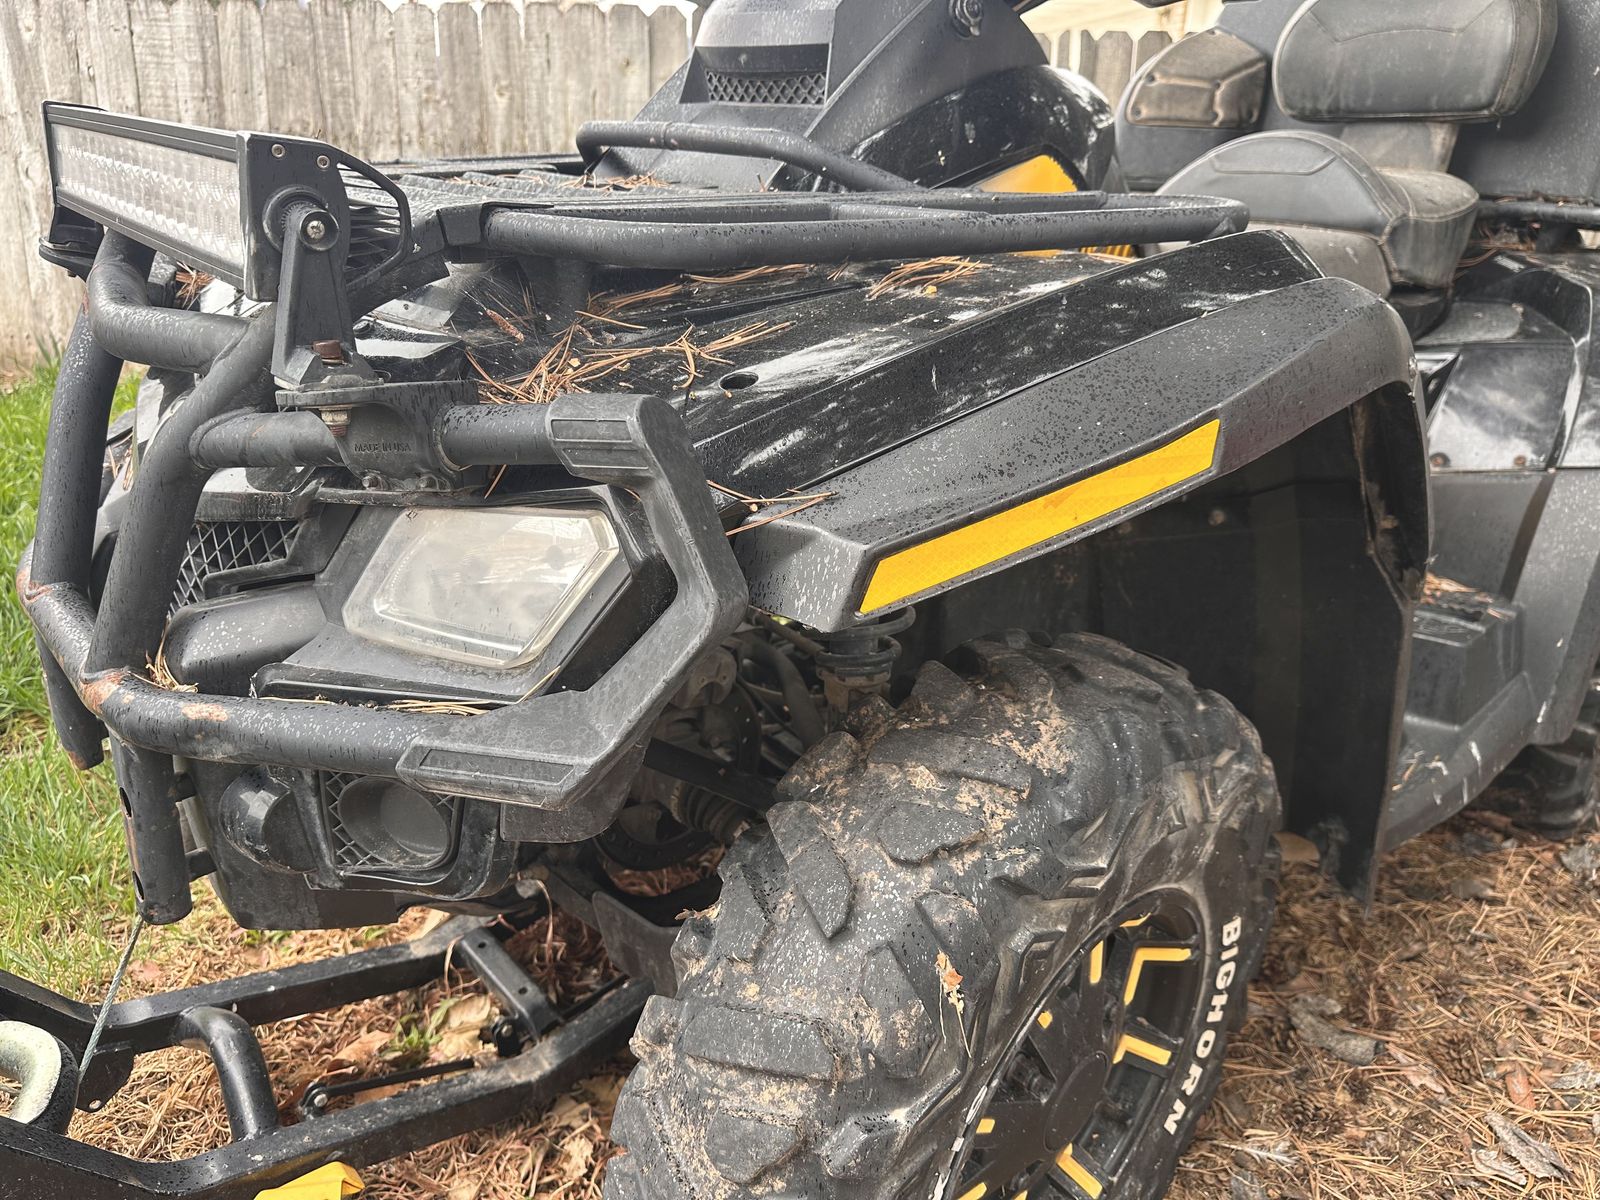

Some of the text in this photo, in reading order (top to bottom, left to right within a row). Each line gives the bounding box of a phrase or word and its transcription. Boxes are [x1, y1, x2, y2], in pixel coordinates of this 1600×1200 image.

[354, 442, 411, 452] MADE IN USA
[1163, 914, 1242, 1136] BIGHORN
